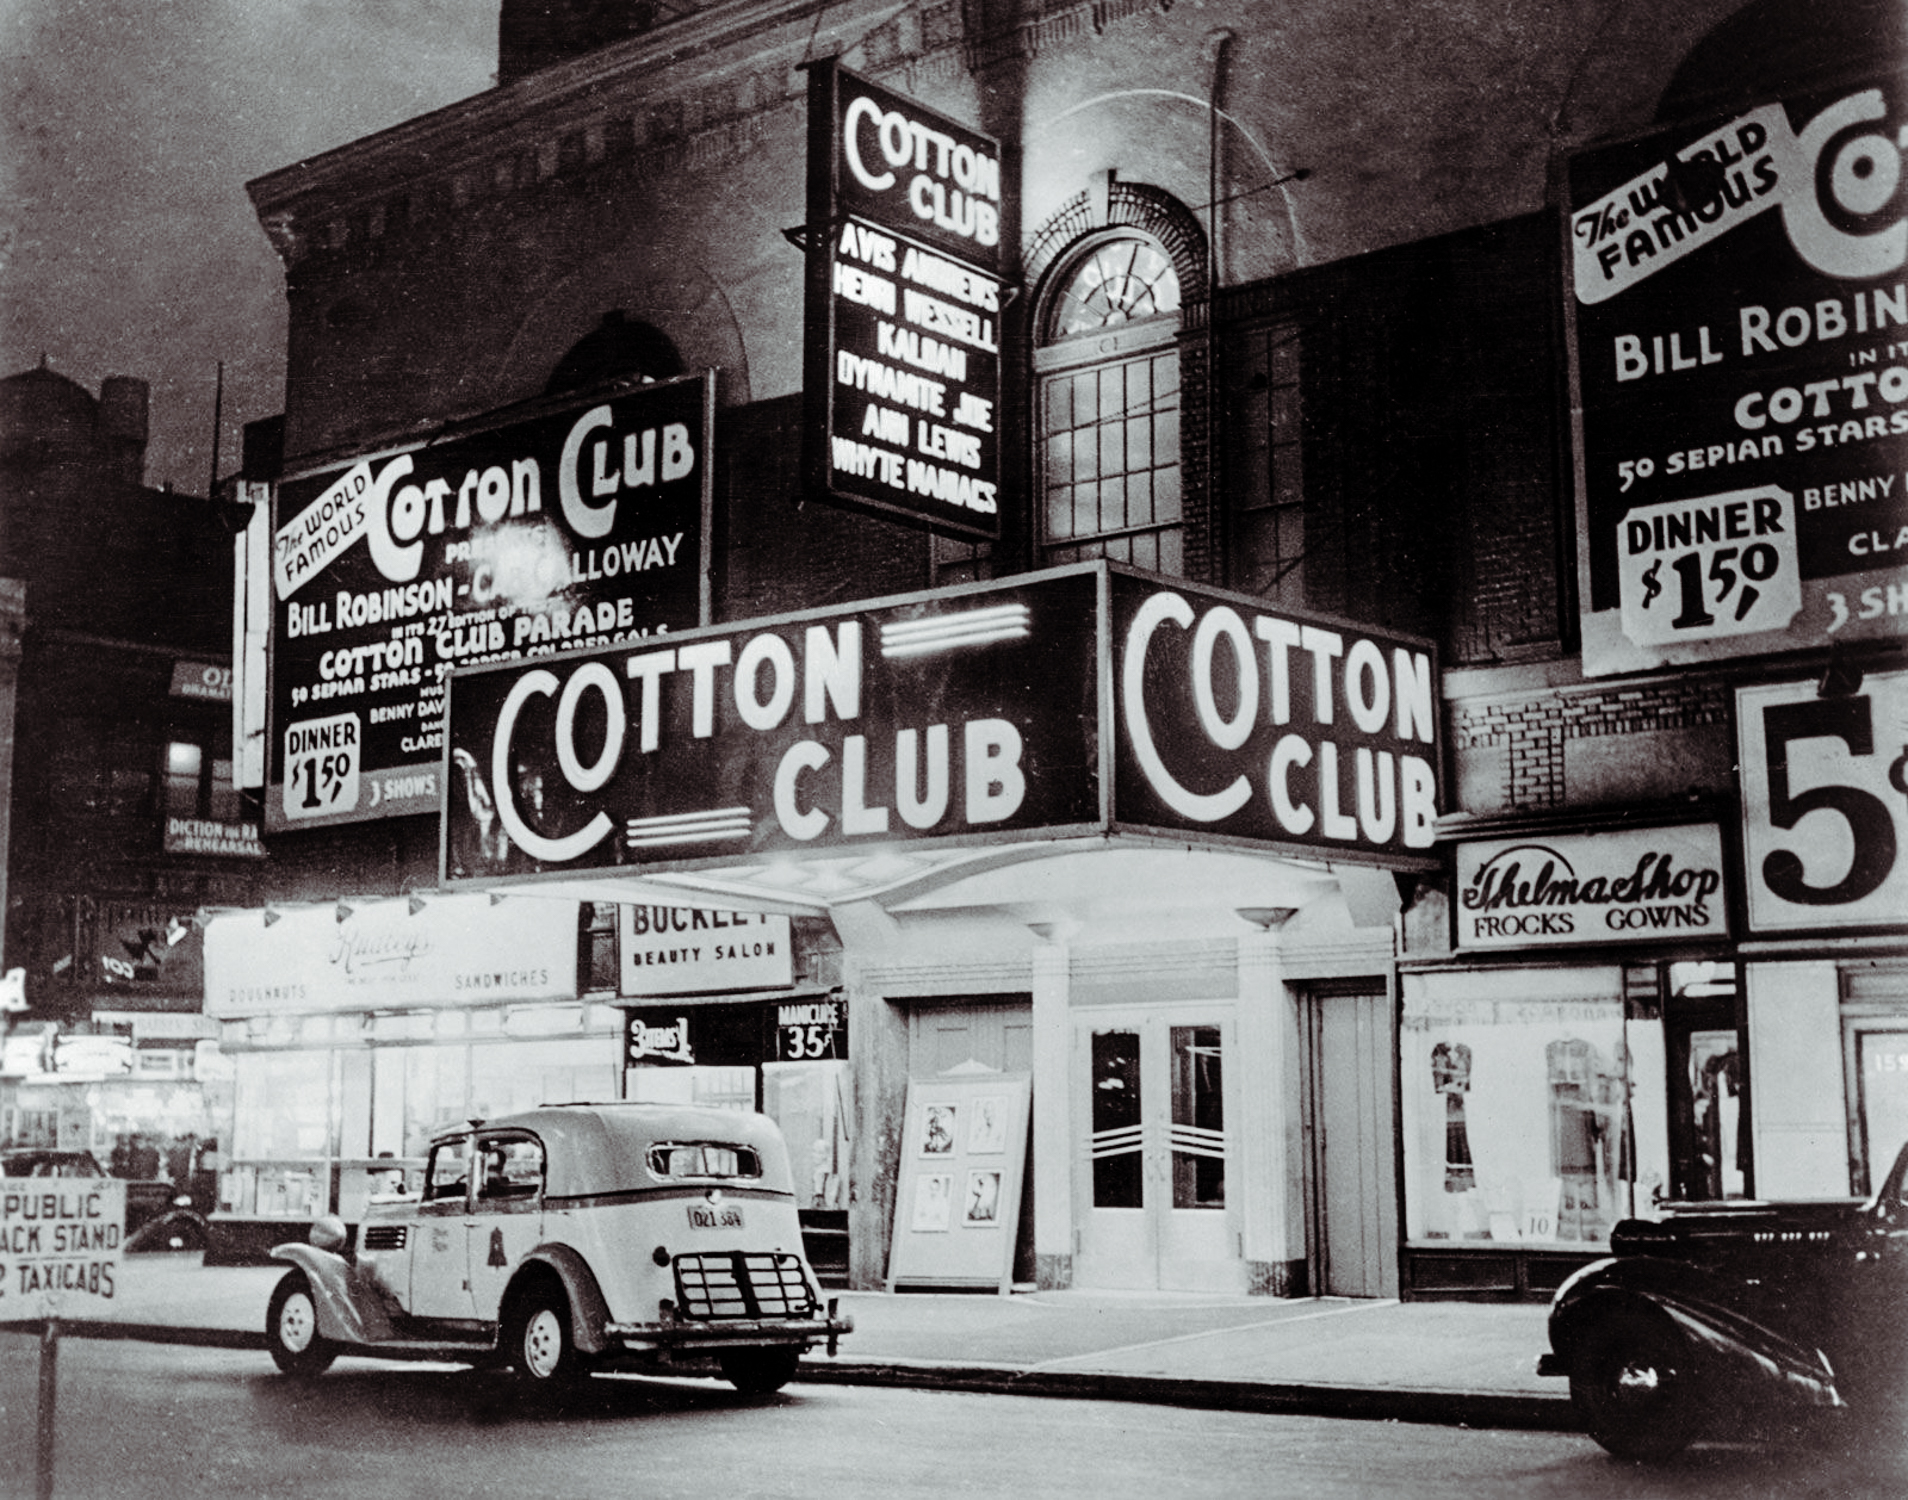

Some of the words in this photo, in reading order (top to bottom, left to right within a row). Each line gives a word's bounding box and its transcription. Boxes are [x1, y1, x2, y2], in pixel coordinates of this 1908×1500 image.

[844, 96, 999, 200] COTTON
[1628, 122, 1768, 217] WLD
[910, 174, 999, 246] CLUB
[1597, 155, 1779, 281] FAMOUS
[839, 222, 896, 273] AVIS
[1614, 325, 1724, 383] BILL
[1739, 284, 1908, 356] ROBIN
[1850, 348, 1877, 367] IN
[837, 349, 946, 418] DYNAMITE
[559, 404, 695, 539] CLUB
[831, 435, 905, 490] WHYTE
[907, 458, 998, 514] MANIACS
[918, 419, 982, 470] LEWIS
[1618, 457, 1655, 493] 50
[1665, 435, 1784, 475] SEPIAN
[1795, 409, 1908, 452] STARS
[305, 475, 366, 537] WORLD
[1803, 474, 1896, 512] BENNY
[284, 502, 366, 582] FAMOUS
[1627, 497, 1785, 556] DINNER
[287, 602, 332, 638] BILL
[336, 576, 453, 630] ROBINSON
[572, 532, 684, 584] LLOWAY
[1826, 592, 1850, 634] 3
[319, 636, 424, 681] COTTON
[435, 621, 506, 659] CLUB
[513, 597, 635, 647] PARADE
[311, 676, 365, 701] SEPIAN
[369, 667, 421, 691] STARS
[370, 703, 415, 724] BENNY
[1123, 590, 1436, 822] COTTON
[289, 722, 357, 756] DINNER
[493, 620, 862, 863] COTTON
[774, 717, 1027, 842] CLUB
[1267, 734, 1439, 850] CLUB
[1474, 912, 1574, 938] FROCKS
[1605, 904, 1710, 931] GOWNS
[455, 969, 549, 990] SANDWICHES
[633, 947, 701, 966] BEAUTY
[715, 942, 775, 960] SALON
[4, 1193, 101, 1220] PUBLIC
[54, 1223, 119, 1252] STAND
[17, 1261, 115, 1299] TAXICABS
